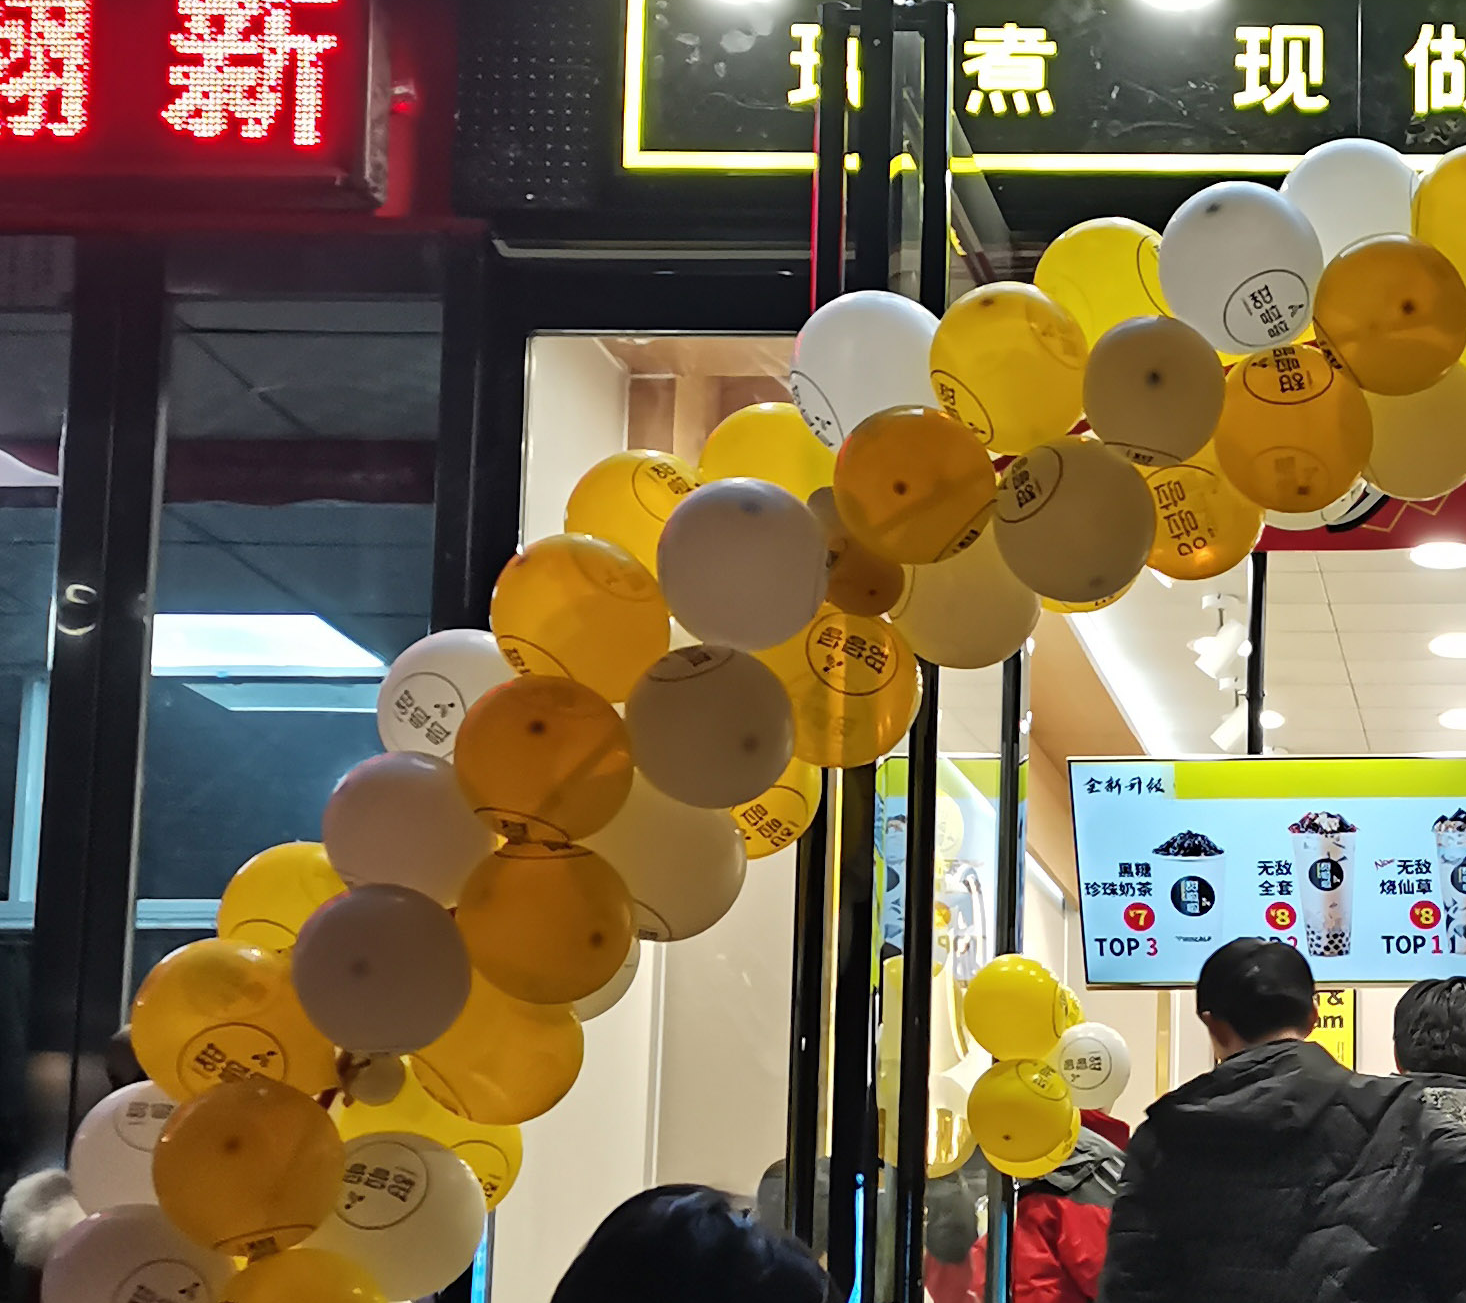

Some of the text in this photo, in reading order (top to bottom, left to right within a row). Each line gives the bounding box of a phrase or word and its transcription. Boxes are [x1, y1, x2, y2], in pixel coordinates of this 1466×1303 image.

[1248, 283, 1291, 339] 甜啦啦
[1257, 860, 1293, 877] 无敌
[1396, 859, 1432, 876] 无敌
[1084, 881, 1154, 898] 珍珠奶茶
[1258, 880, 1294, 897] 全套
[1379, 879, 1433, 896] 烧仙草
[1094, 937, 1159, 957] TOP 3
[1381, 934, 1443, 955] TOP 1
